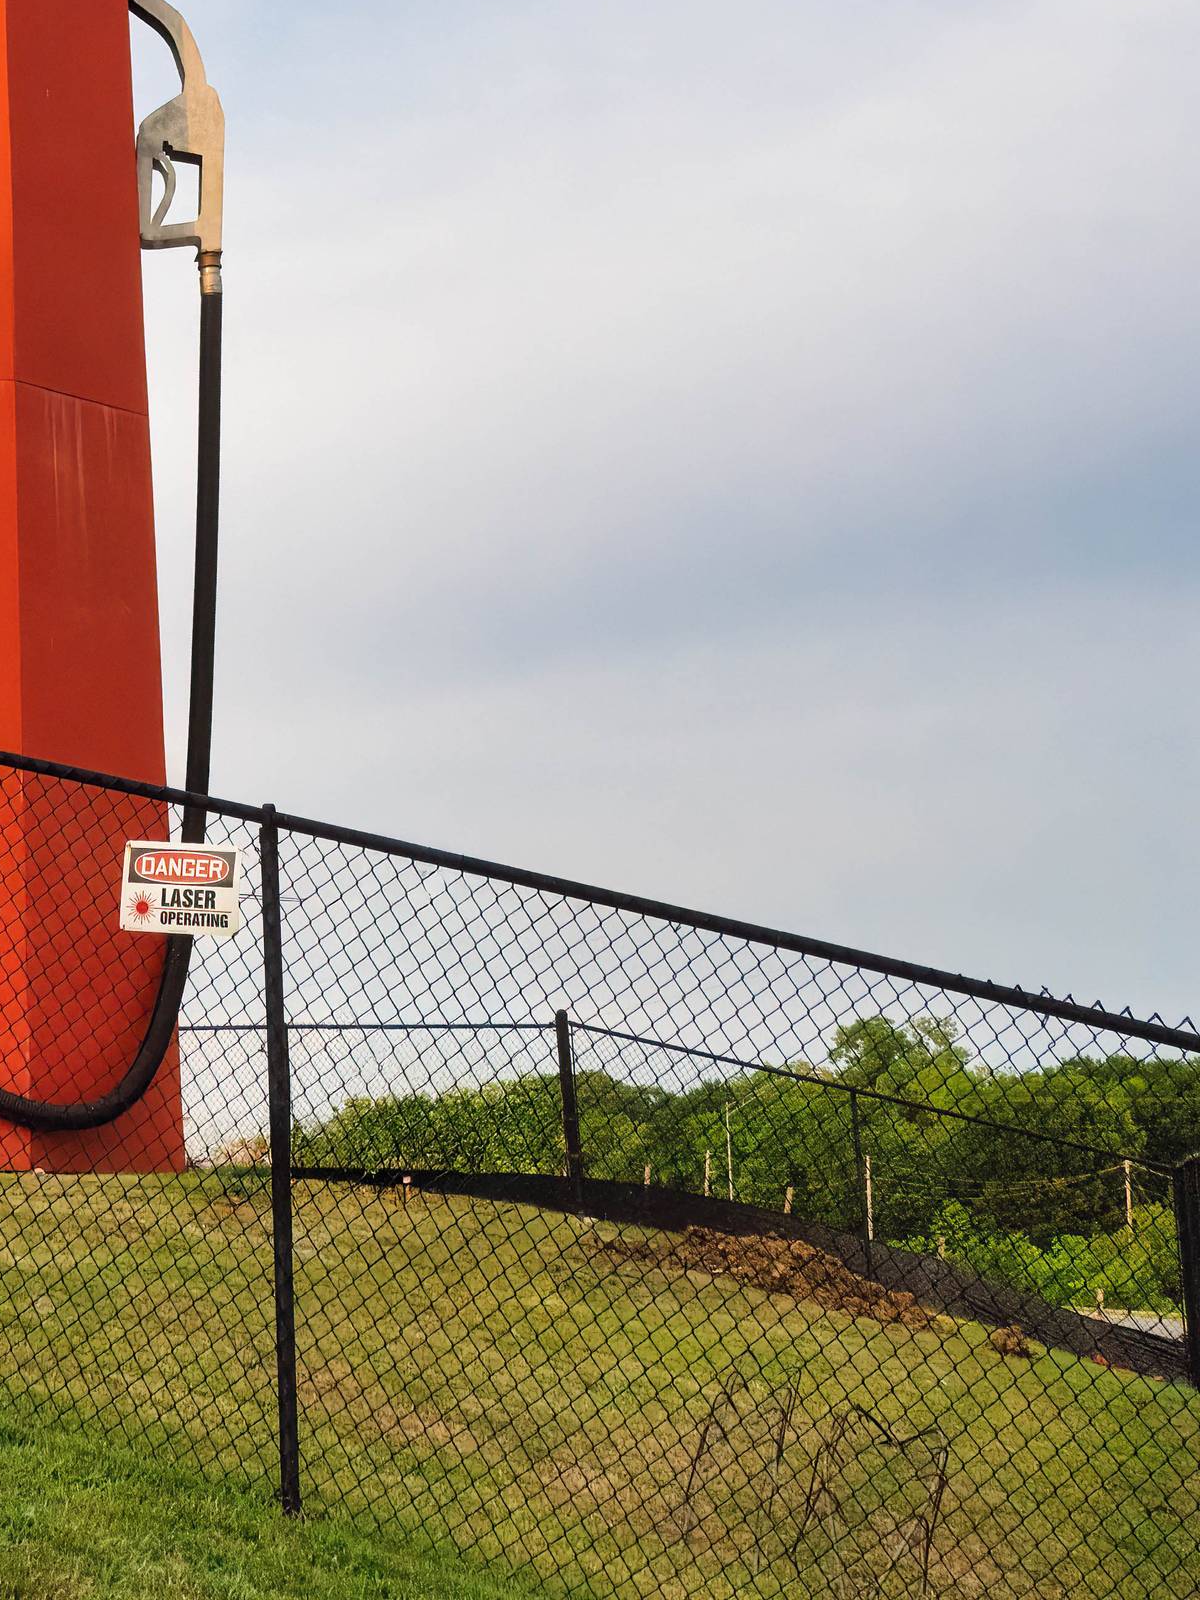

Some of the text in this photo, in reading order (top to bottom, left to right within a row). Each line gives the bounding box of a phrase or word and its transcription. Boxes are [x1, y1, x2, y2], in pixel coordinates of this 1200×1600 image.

[141, 856, 223, 879] DANGER
[161, 888, 216, 909] LASER
[160, 911, 229, 928] OPERATING
